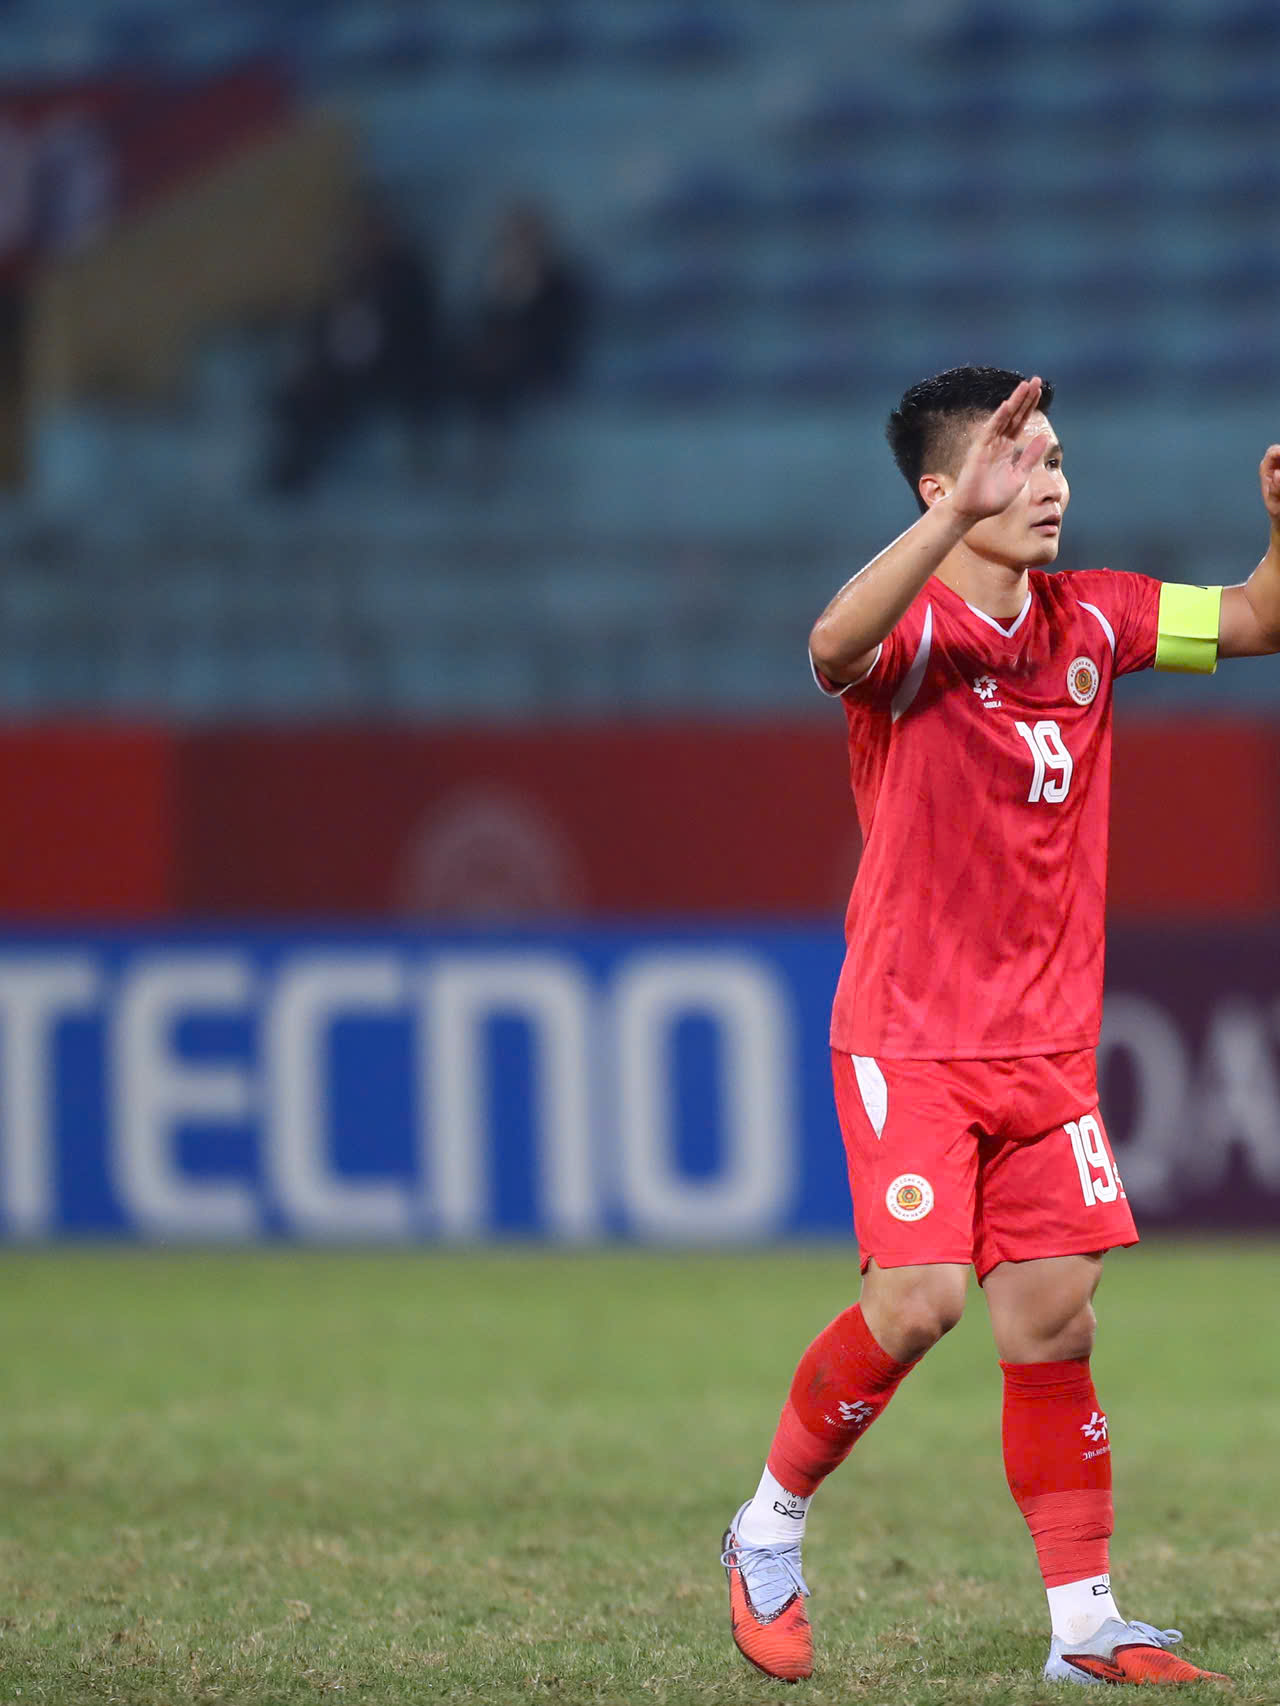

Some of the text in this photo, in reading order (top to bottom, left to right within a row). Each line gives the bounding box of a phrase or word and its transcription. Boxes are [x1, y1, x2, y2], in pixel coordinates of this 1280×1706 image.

[1014, 720, 1074, 803] 19
[0, 950, 797, 1241] TECNO
[1063, 1114, 1118, 1207] 19
